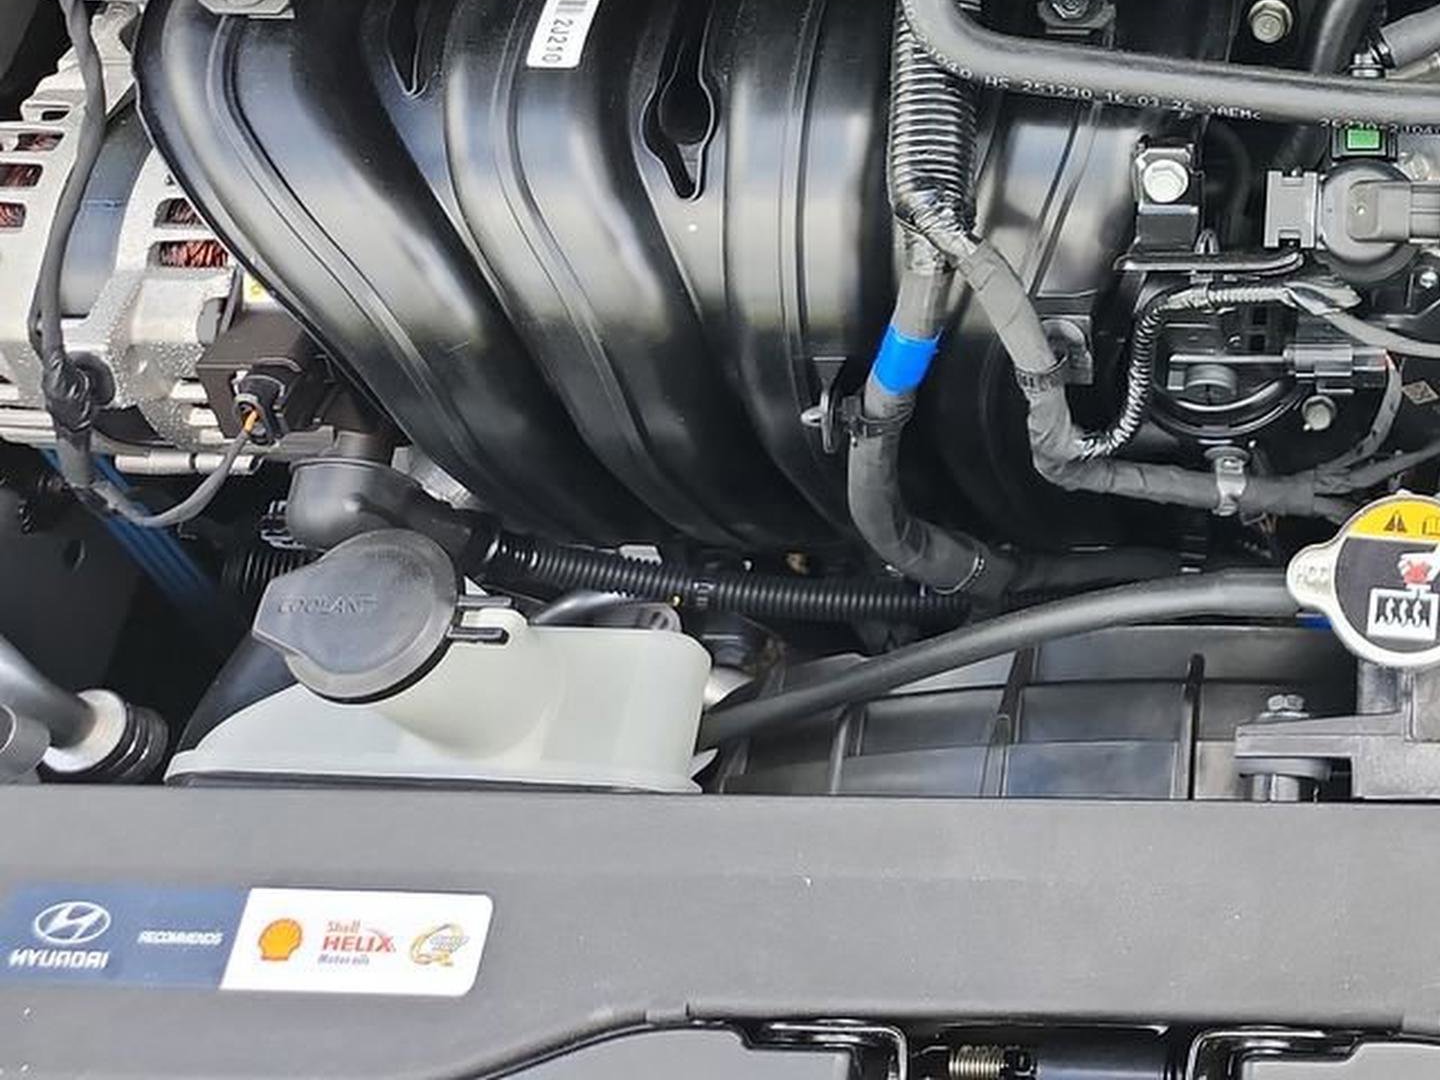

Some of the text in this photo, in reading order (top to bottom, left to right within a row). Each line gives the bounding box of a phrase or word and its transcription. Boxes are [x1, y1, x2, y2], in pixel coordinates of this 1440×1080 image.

[541, 19, 574, 64] 2J210
[327, 920, 361, 934] Shell
[8, 928, 396, 968] HYUNDAI RECOMMENDS HELIX
